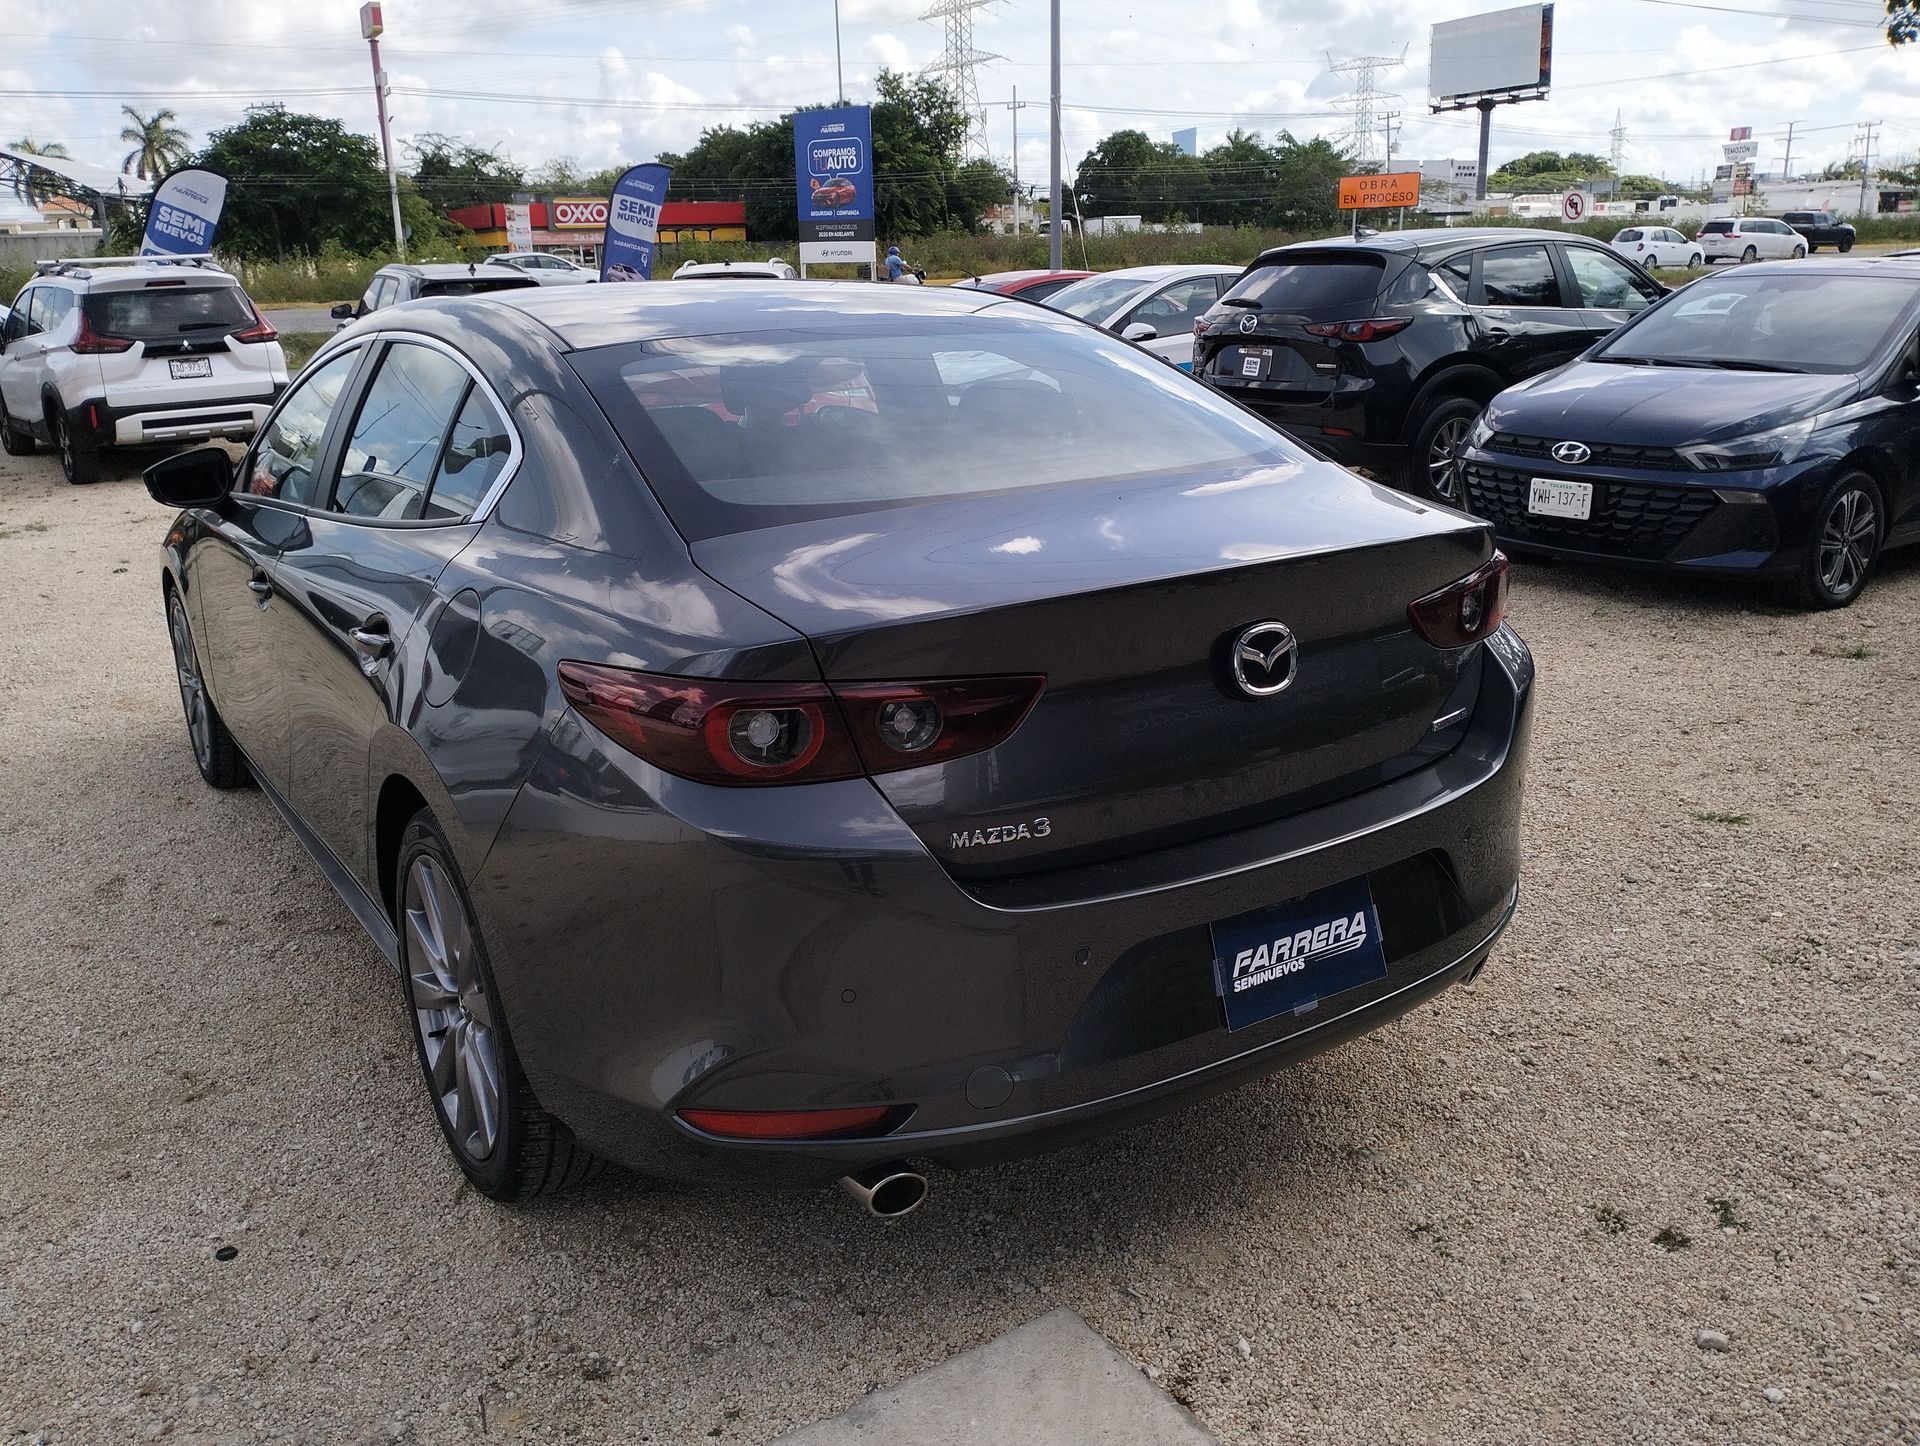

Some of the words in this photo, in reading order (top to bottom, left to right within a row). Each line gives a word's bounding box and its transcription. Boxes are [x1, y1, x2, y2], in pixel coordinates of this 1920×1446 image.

[813, 146, 856, 158] COMPRAMOS
[813, 157, 828, 171] TU
[827, 155, 857, 170] AUTO
[1359, 179, 1398, 190] OBRA
[1343, 195, 1357, 204] EN
[1362, 191, 1414, 204] PROCESO
[556, 202, 608, 224] OXXO
[618, 198, 656, 219] SEMI
[158, 205, 206, 236] SEMI
[616, 212, 654, 228] NUEVOS
[154, 220, 204, 246] NUEVOS
[1533, 487, 1589, 508] YWH-137-F
[1232, 911, 1367, 978] FARRERA
[1233, 958, 1305, 993] SEMINUEVOS
